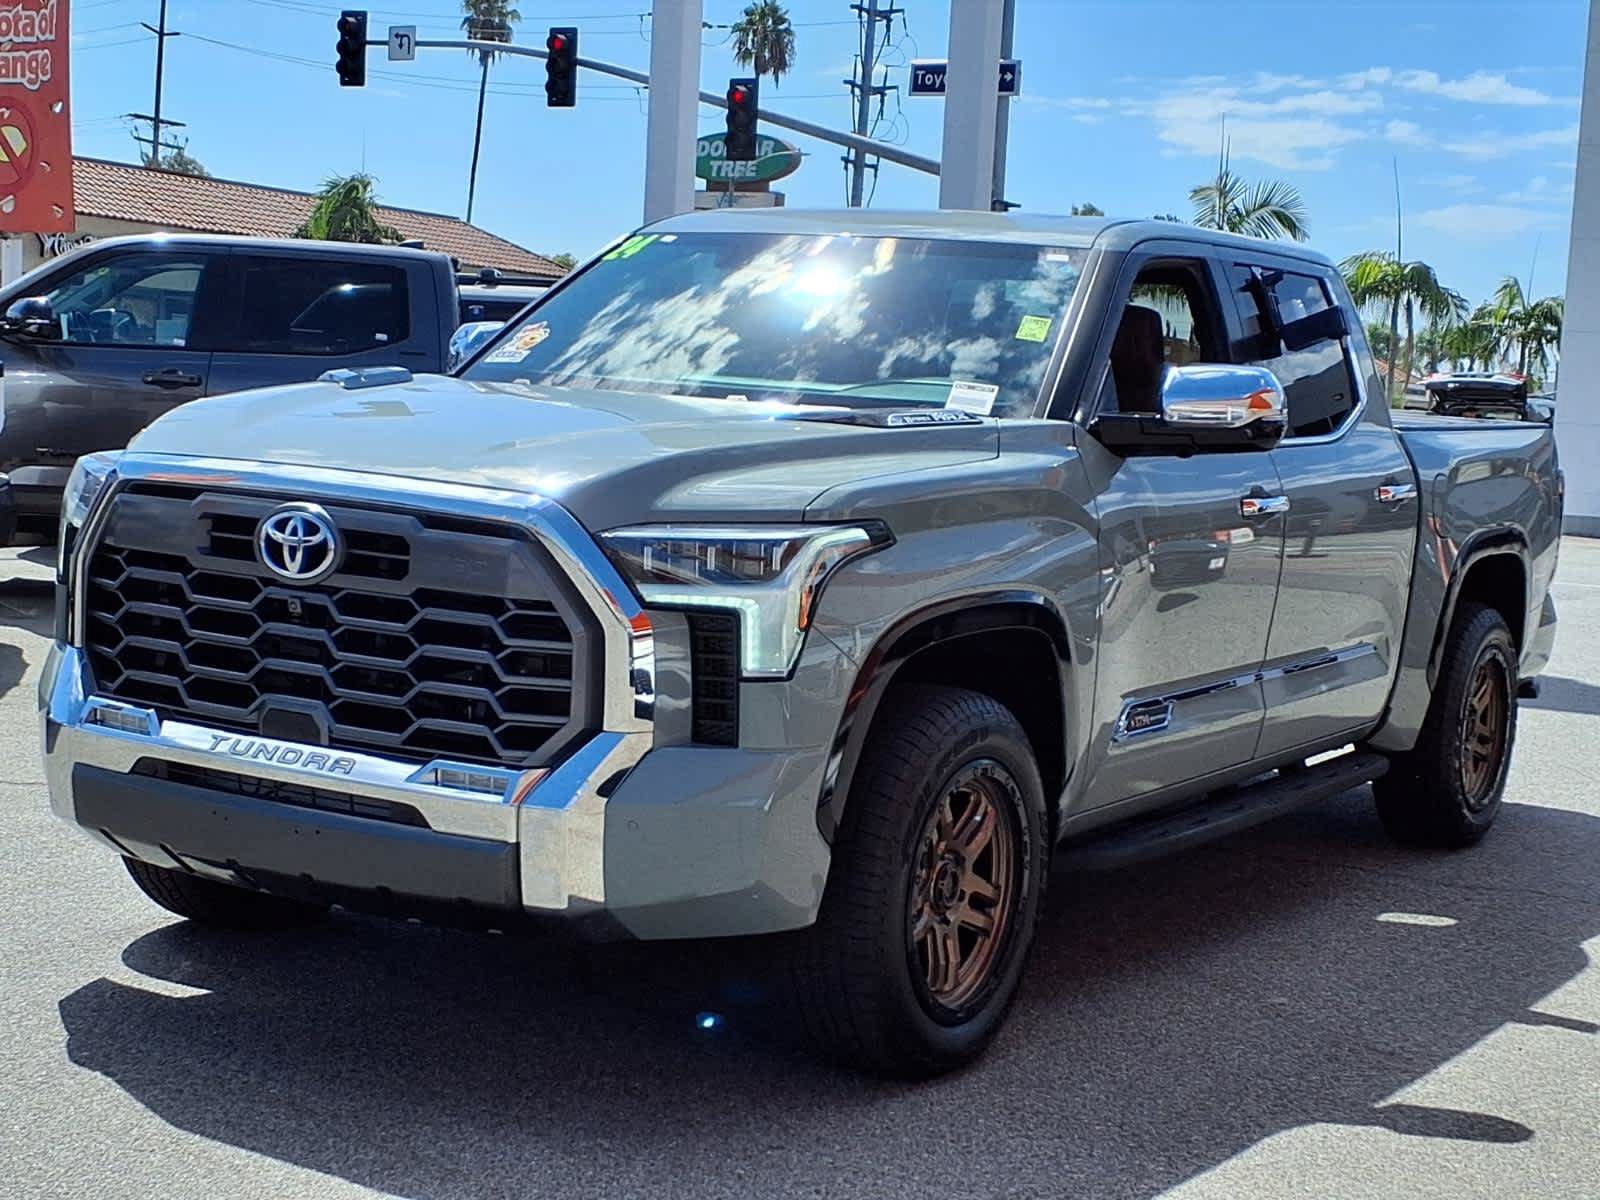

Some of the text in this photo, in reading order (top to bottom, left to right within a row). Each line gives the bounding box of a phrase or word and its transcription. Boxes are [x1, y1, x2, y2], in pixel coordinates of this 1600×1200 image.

[916, 70, 947, 88] Toy
[697, 140, 775, 157] DOR
[710, 161, 757, 177] TREE
[208, 734, 356, 775] TUNDRA
